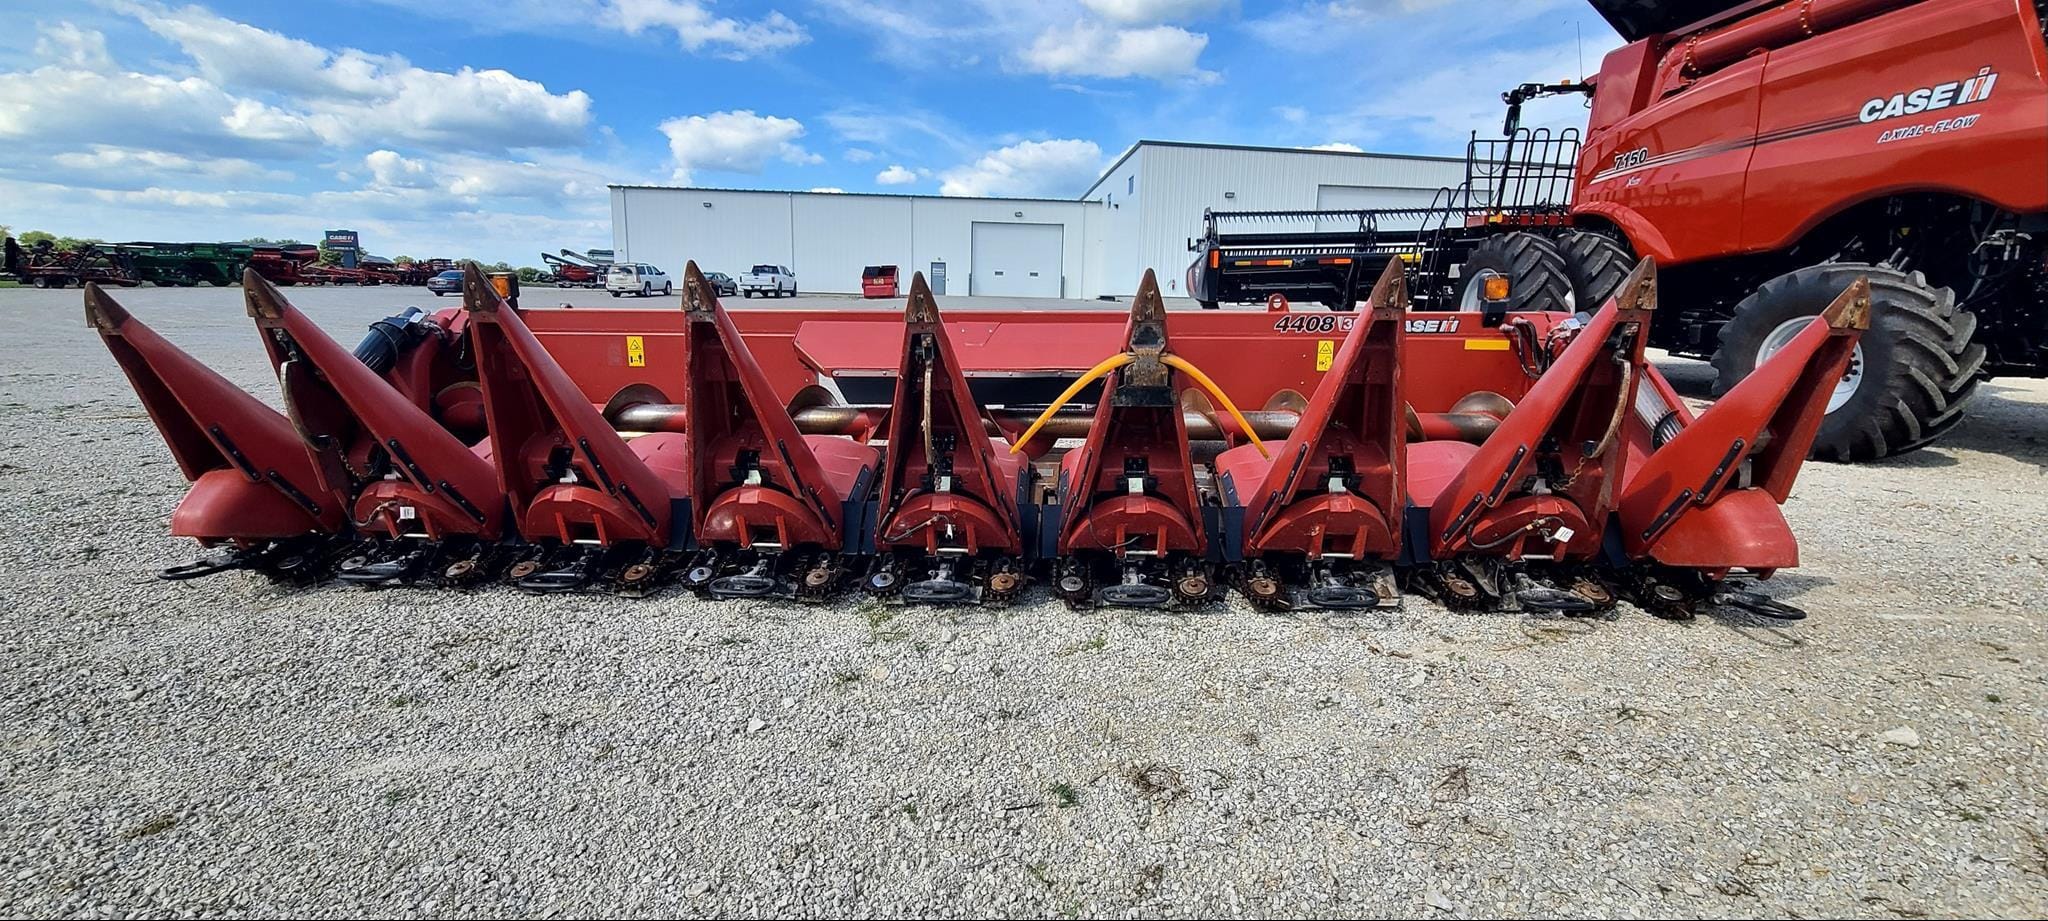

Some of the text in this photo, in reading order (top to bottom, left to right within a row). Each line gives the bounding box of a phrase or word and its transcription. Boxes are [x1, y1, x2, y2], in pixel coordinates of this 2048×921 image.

[1859, 82, 1959, 123] CASE
[1877, 114, 1981, 143] AXIAL-FLOW
[1614, 147, 1648, 170] 7150
[1274, 315, 1337, 333] 4408
[1405, 320, 1440, 332] SE
